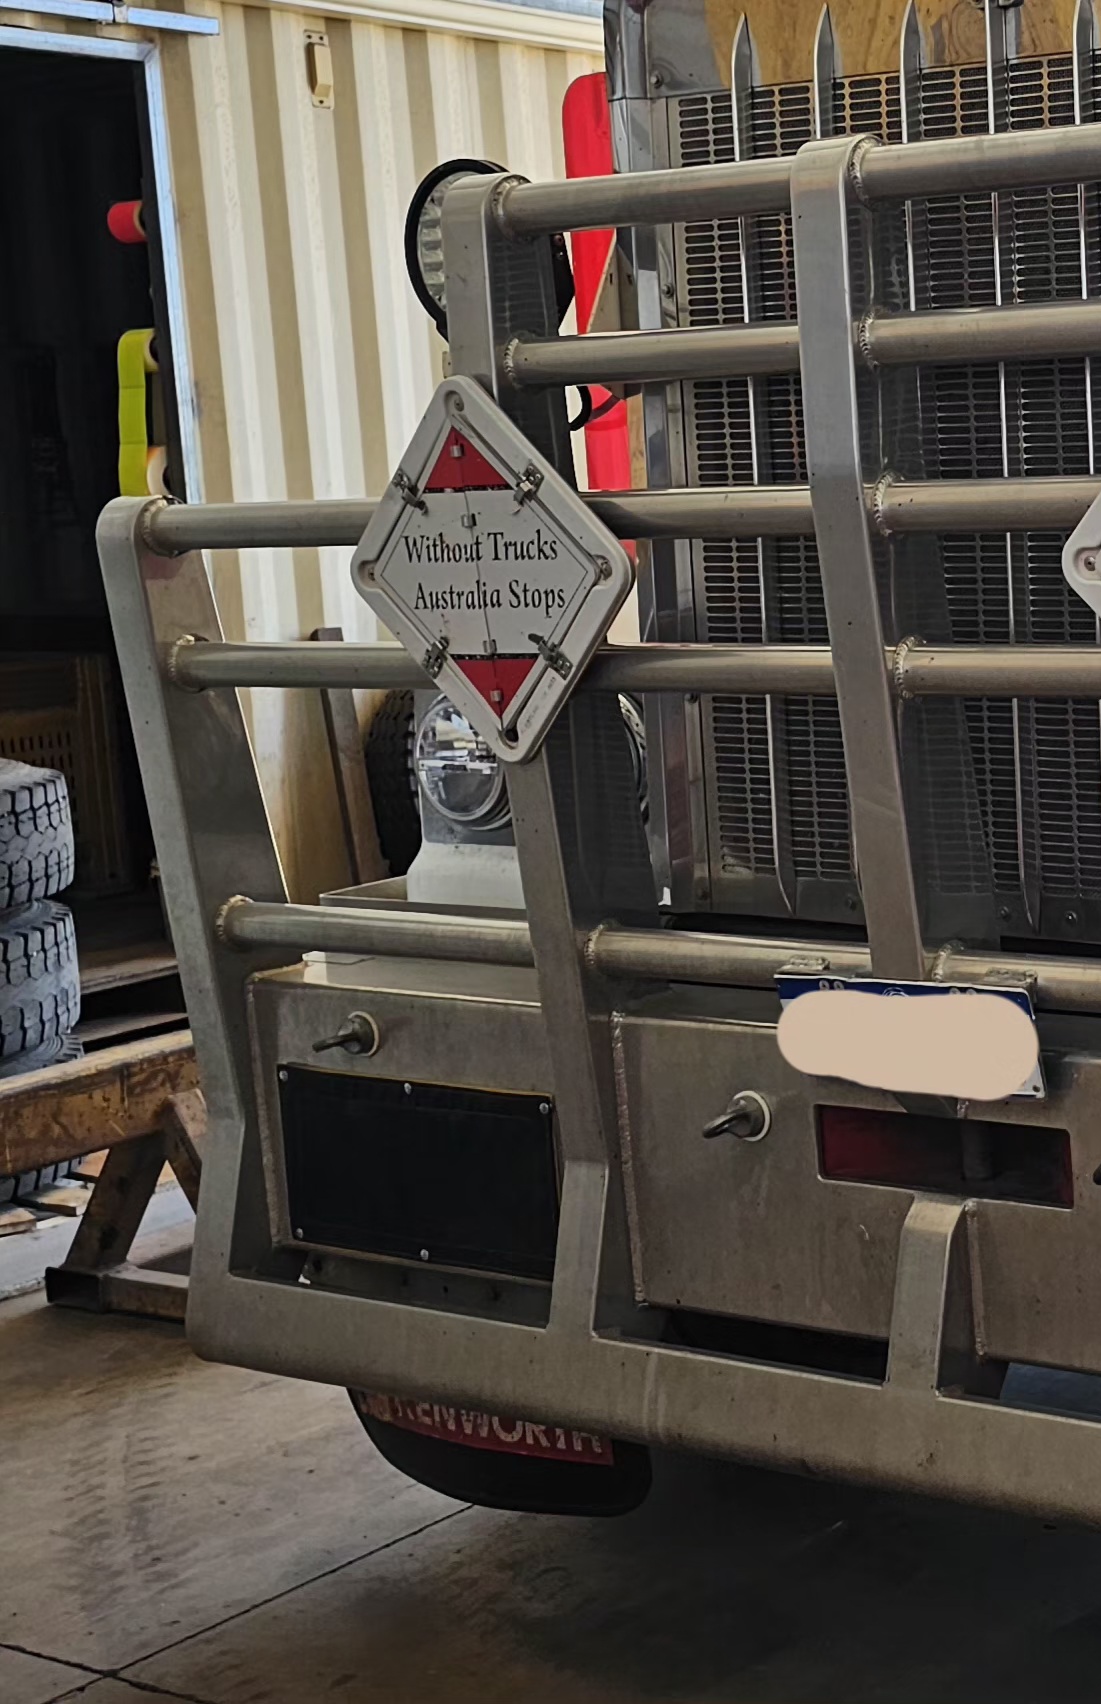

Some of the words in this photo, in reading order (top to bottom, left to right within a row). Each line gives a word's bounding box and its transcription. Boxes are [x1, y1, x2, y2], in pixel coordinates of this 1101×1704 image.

[403, 532, 483, 563] Without
[487, 528, 559, 563] Trucks
[414, 582, 504, 612] Australia
[508, 580, 567, 619] Stops
